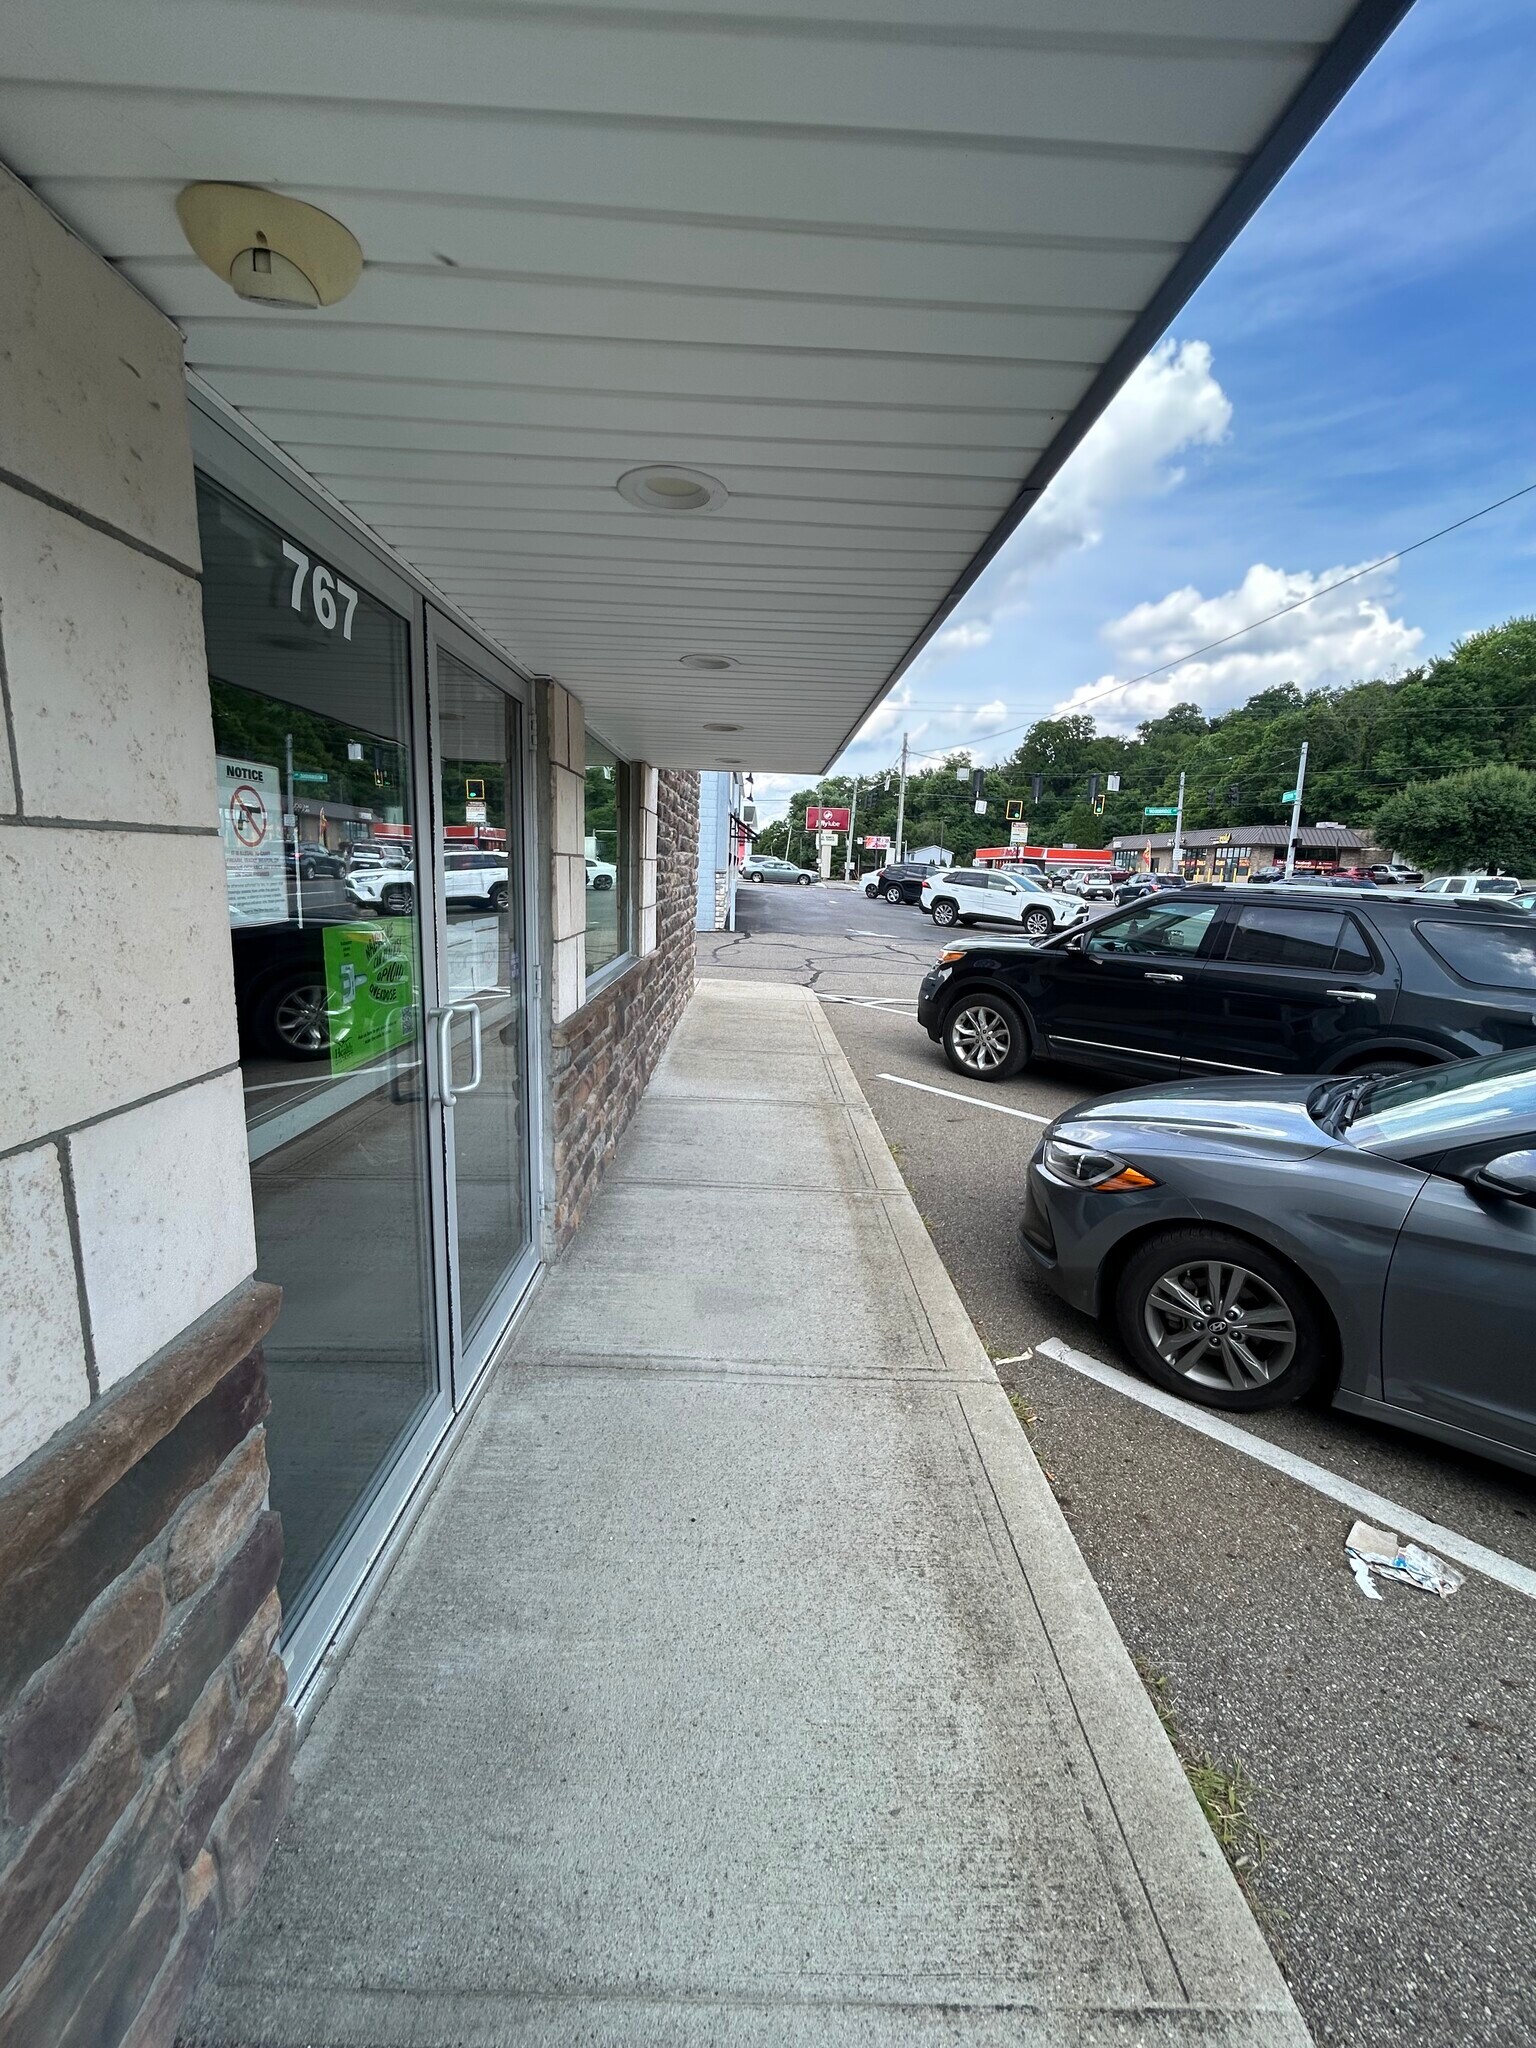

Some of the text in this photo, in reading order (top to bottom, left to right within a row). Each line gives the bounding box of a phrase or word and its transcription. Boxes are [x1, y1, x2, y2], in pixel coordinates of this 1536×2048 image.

[282, 540, 358, 640] 767
[226, 765, 264, 781] NOTICE
[370, 984, 397, 1000] OVERDOSE
